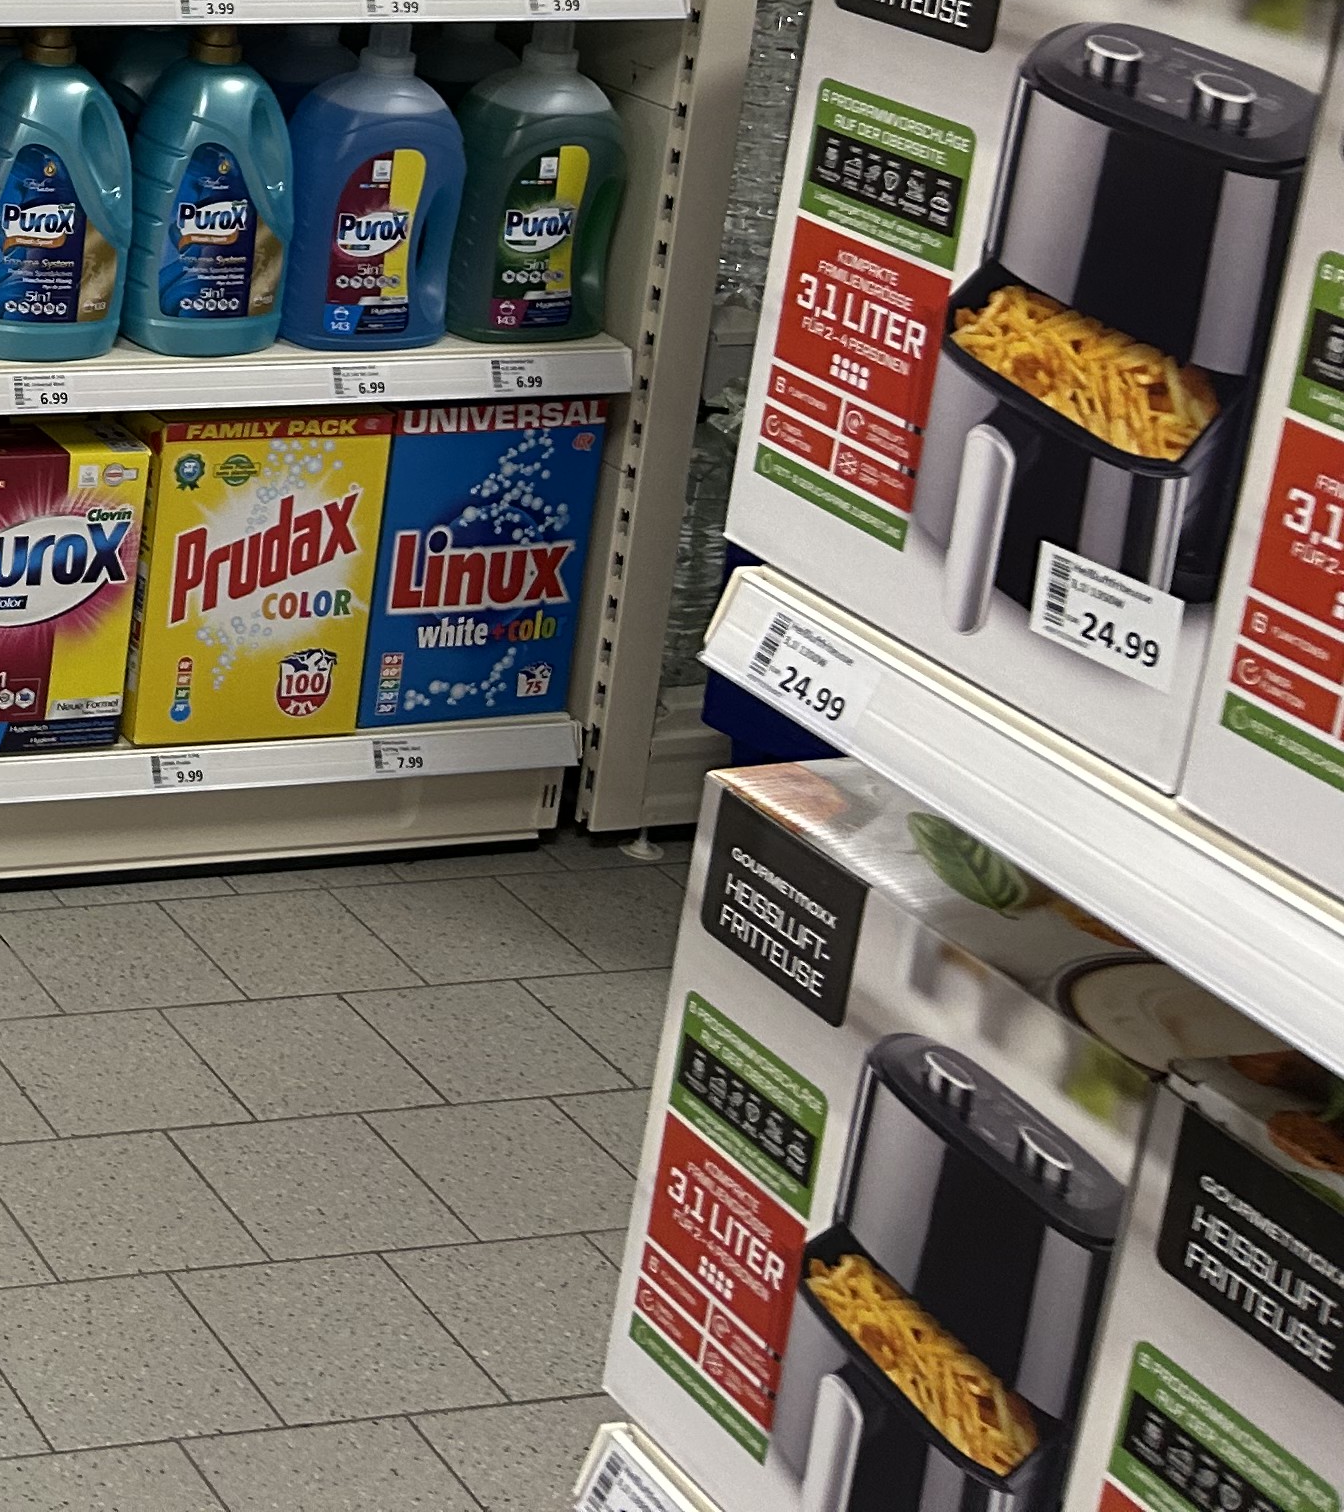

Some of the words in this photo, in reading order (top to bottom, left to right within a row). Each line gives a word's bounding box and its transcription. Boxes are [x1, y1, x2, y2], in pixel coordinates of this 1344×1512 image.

[392, 2, 419, 14] 3.99
[554, 0, 580, 11] 3.99
[179, 202, 247, 231] PuroX
[796, 275, 841, 329] 3,1
[843, 285, 926, 359] LITER
[516, 376, 542, 387] 6.99
[186, 422, 285, 439] FAMILY
[292, 419, 358, 435] PACK
[403, 400, 605, 434] UNIVERSAL
[87, 508, 131, 522] Clovin
[170, 492, 359, 625] Prudax
[390, 528, 571, 610] Linux
[262, 589, 352, 619] COLOR
[417, 618, 488, 648] white
[1082, 613, 1159, 667] 24.99
[286, 673, 324, 693] 100
[525, 680, 542, 694] 75
[778, 667, 846, 720] 24.99
[56, 701, 83, 713] Neue
[86, 699, 121, 711] Formel
[176, 770, 203, 783] 9.99
[397, 756, 423, 769] 7.99
[725, 874, 831, 962] HEISSLUFT-
[719, 904, 823, 998] FRITTEUSE
[1191, 1204, 1342, 1331] HEISSLUFT-
[1184, 1241, 1337, 1371] FRITTEUSE
